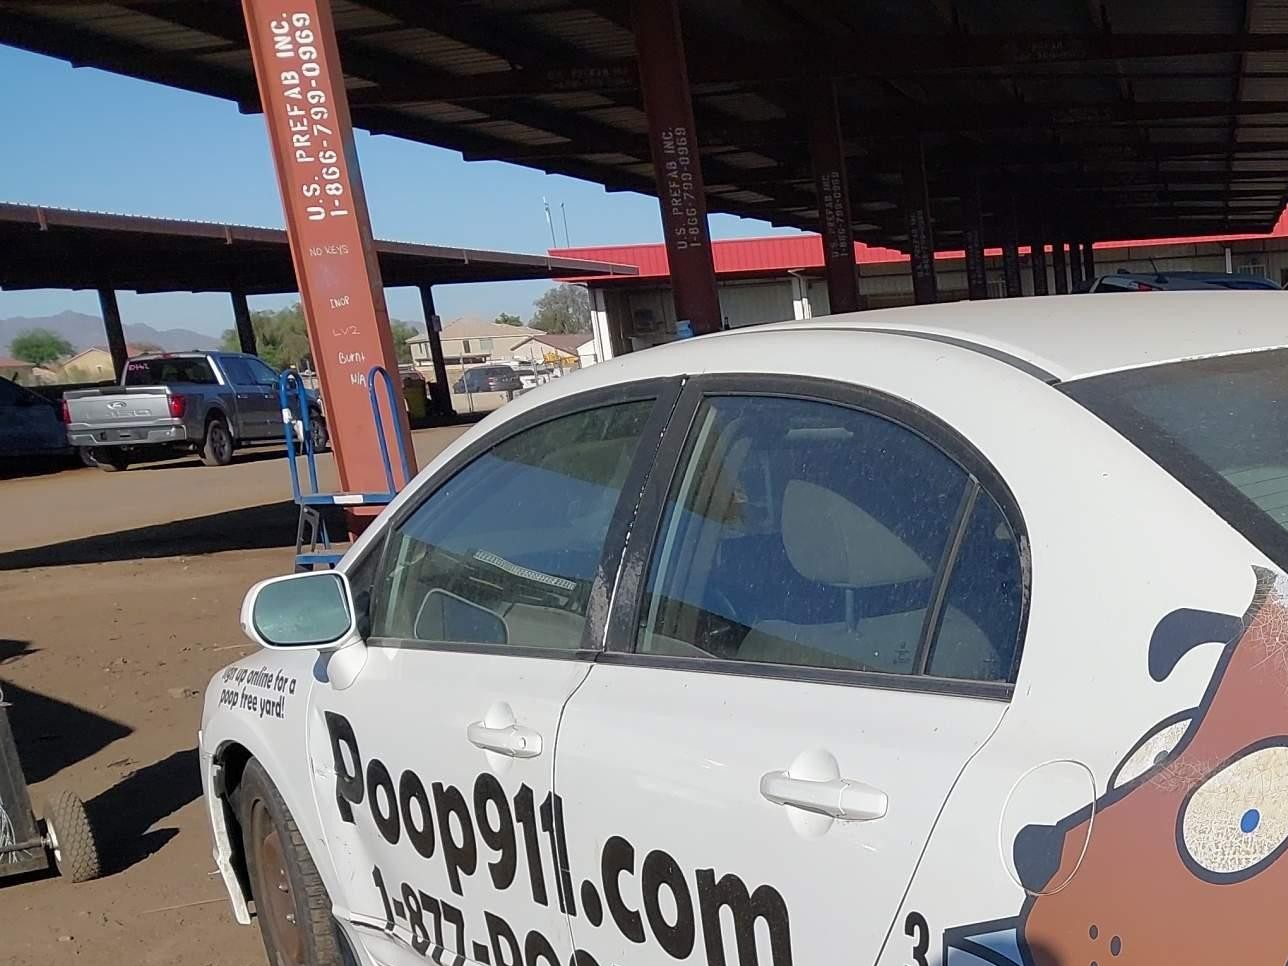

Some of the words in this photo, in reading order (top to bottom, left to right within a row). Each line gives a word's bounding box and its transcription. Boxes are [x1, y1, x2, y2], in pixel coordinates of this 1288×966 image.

[270, 13, 294, 57] INC.
[280, 71, 315, 162] PREFAB
[292, 13, 348, 216] 1-866-799-0969
[662, 127, 675, 154] INC.
[303, 176, 326, 220] U.S.
[666, 161, 684, 215] PREFAB
[675, 224, 688, 249] U.S.
[236, 668, 248, 686] up
[247, 666, 273, 689] online
[274, 669, 289, 693] for
[289, 678, 297, 695] a
[219, 688, 239, 710] poop
[240, 687, 258, 711] free
[260, 695, 285, 719] yard!
